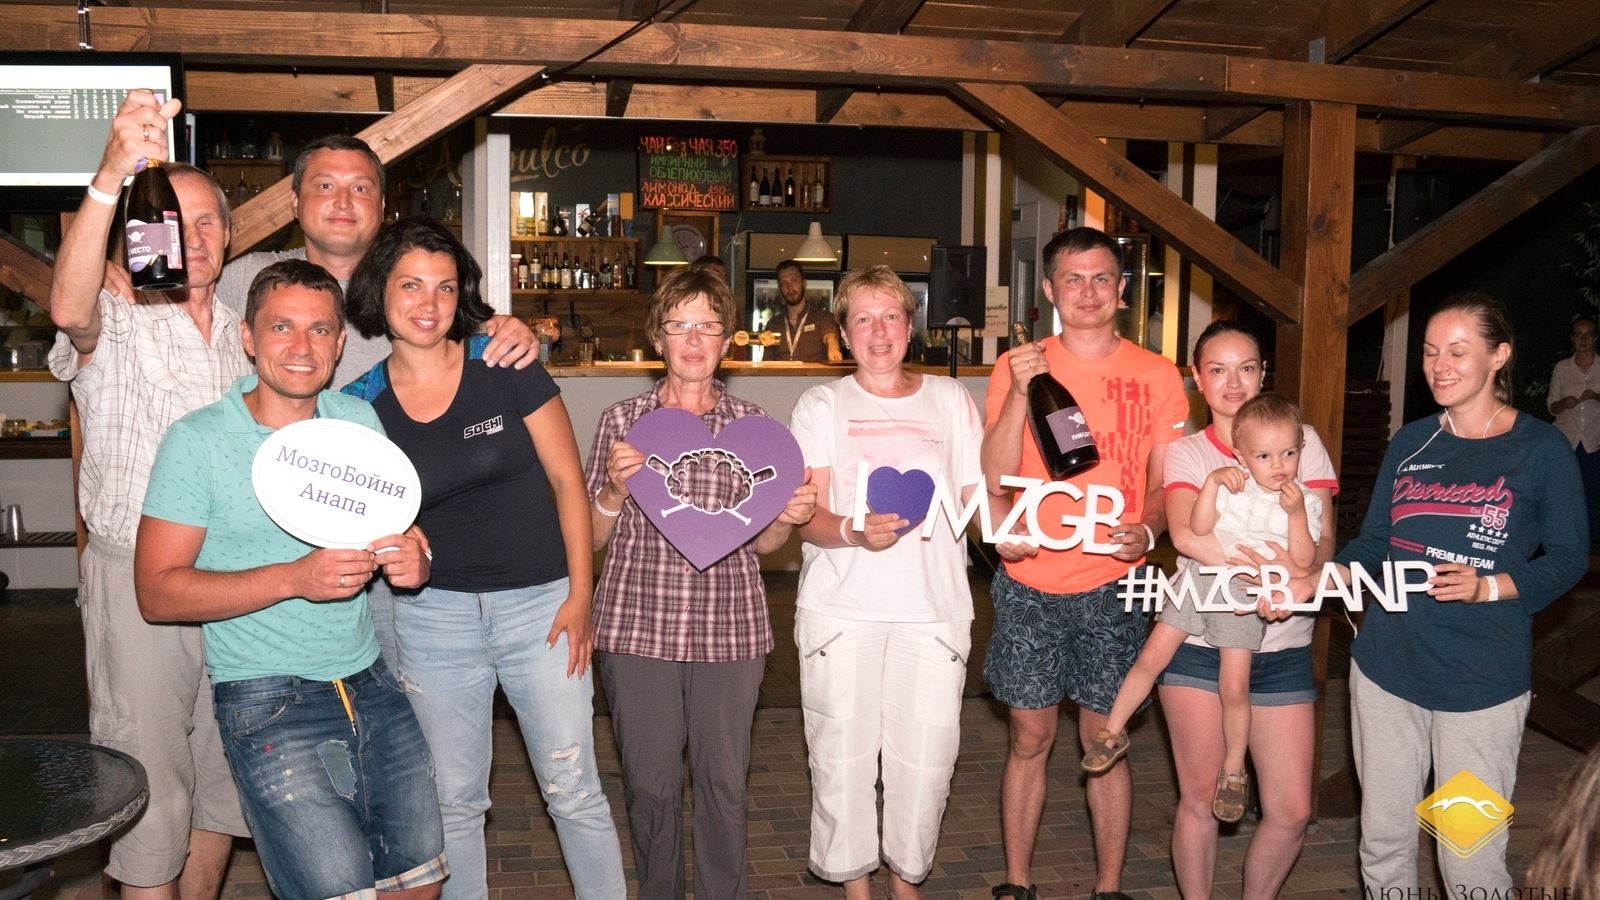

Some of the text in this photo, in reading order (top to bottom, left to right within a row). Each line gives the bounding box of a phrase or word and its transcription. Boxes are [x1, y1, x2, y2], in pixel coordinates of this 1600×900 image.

[130, 245, 151, 255] МЕСТО
[464, 415, 503, 439] SOCHI
[276, 445, 406, 499] МозгоБойня
[299, 482, 367, 516] Анапа
[852, 461, 1126, 555] I MZGB
[1481, 504, 1509, 530] 55
[1466, 532, 1493, 543] ATHLETIC
[1425, 546, 1495, 570] PREMIUM TEAM
